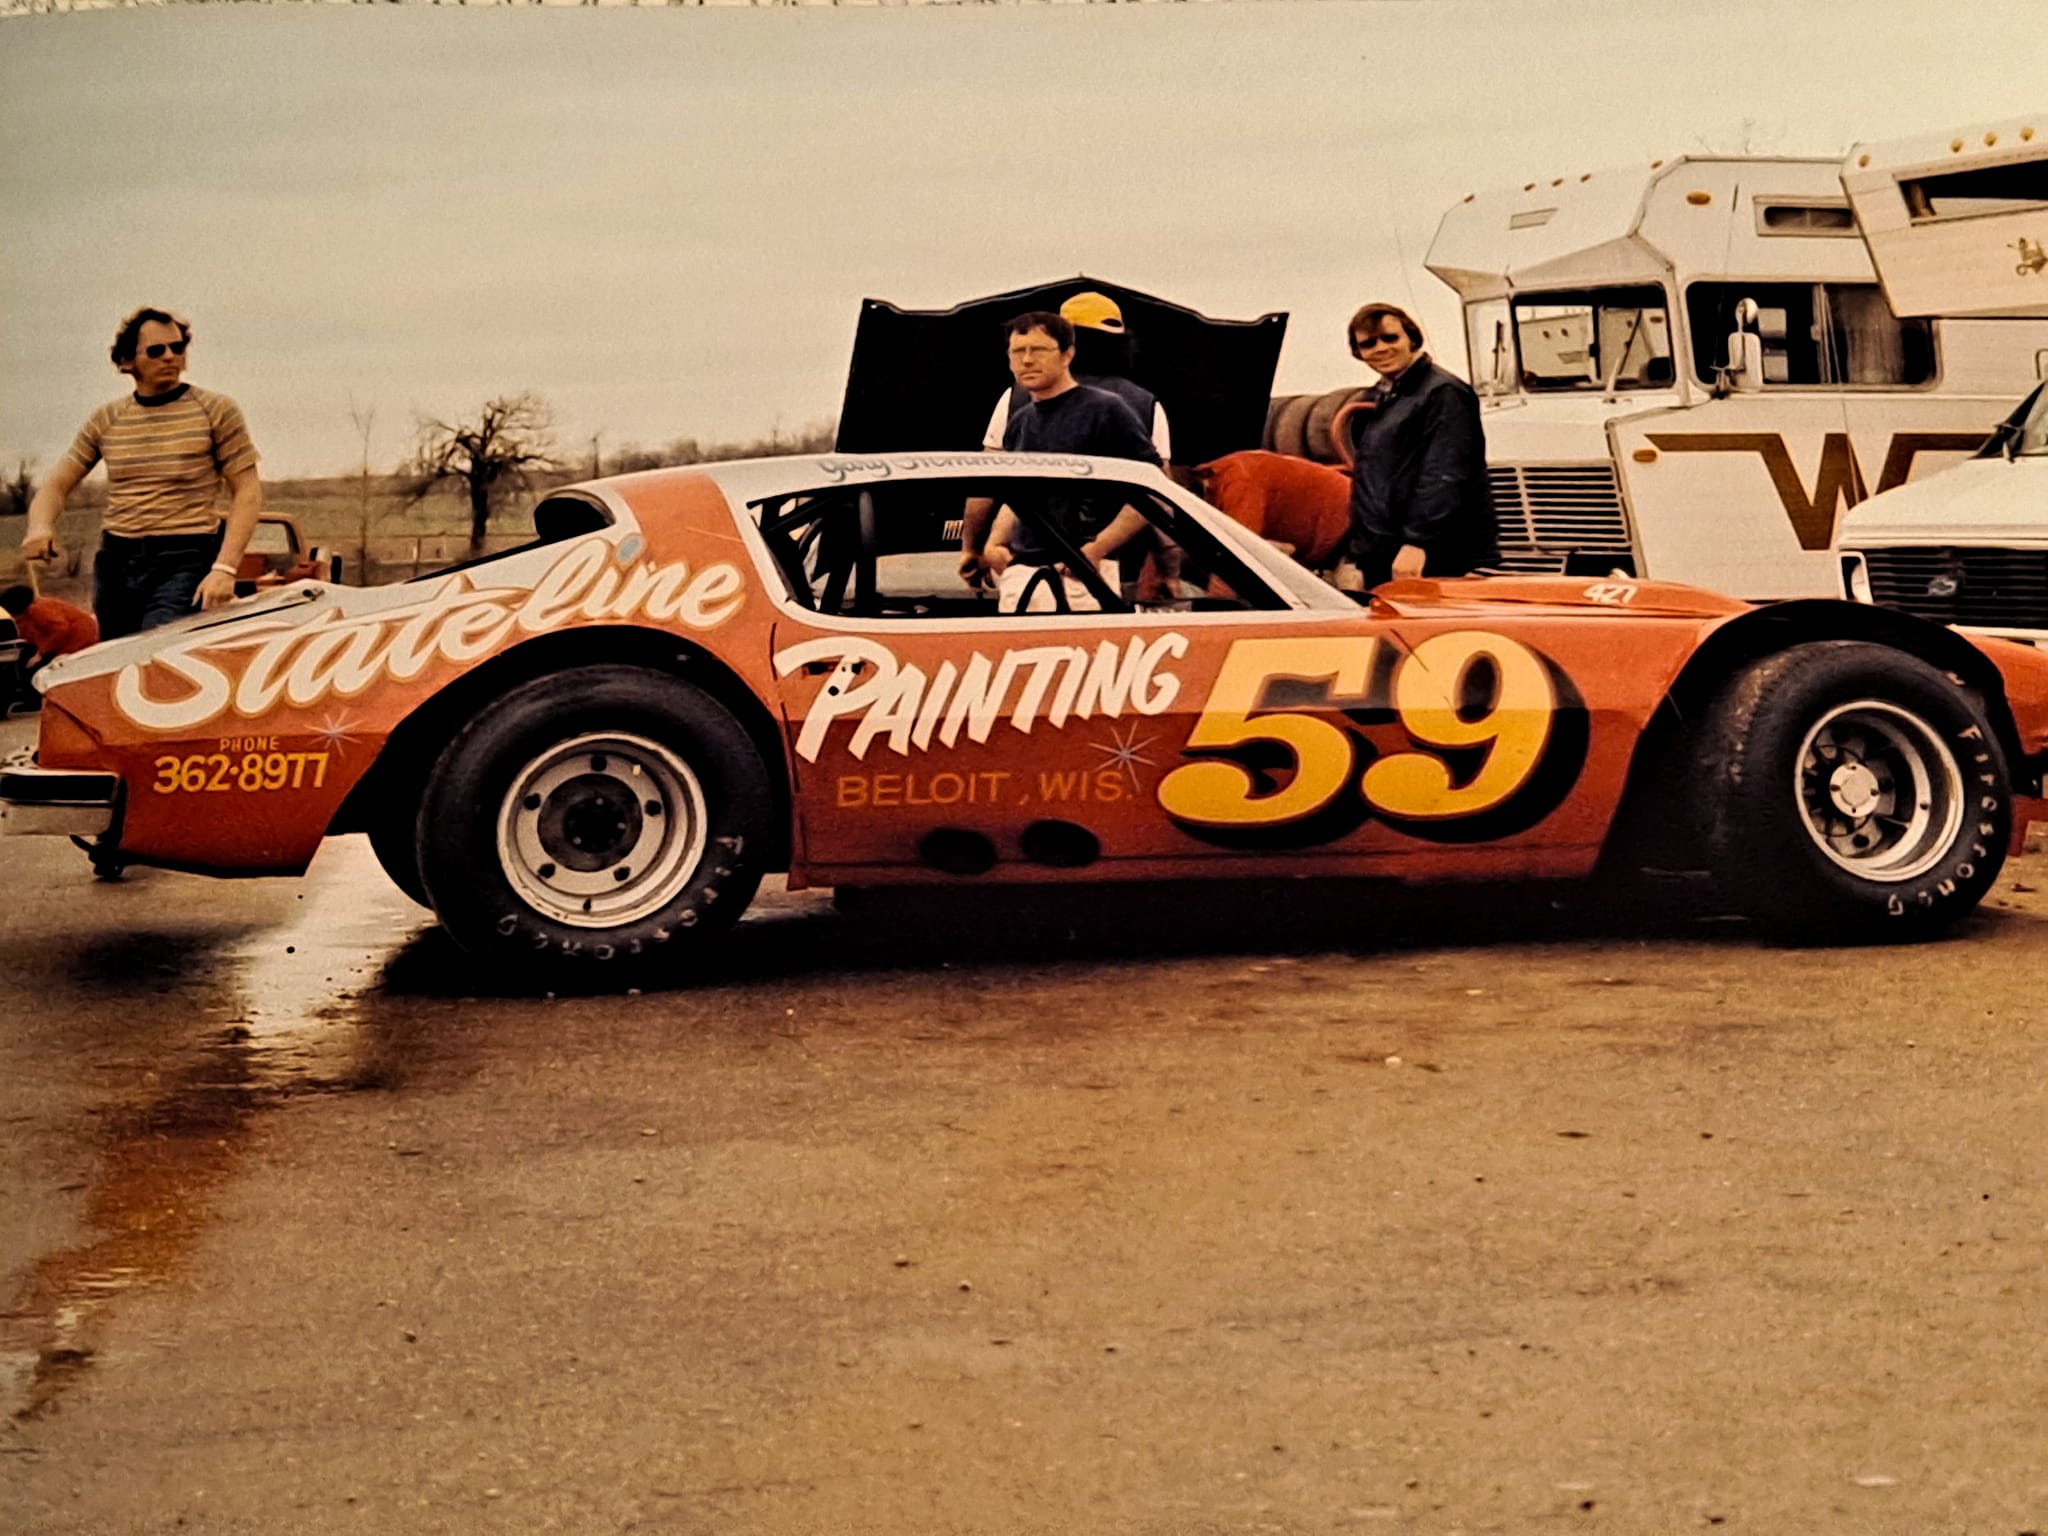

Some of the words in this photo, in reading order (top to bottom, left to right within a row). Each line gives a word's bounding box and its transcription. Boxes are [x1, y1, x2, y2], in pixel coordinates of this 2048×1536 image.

[1582, 583, 1638, 605] 427
[772, 631, 1190, 764] PAINTING
[218, 735, 281, 752] PHONE
[1156, 630, 1556, 826] 59
[1038, 769, 1133, 804] WIS.
